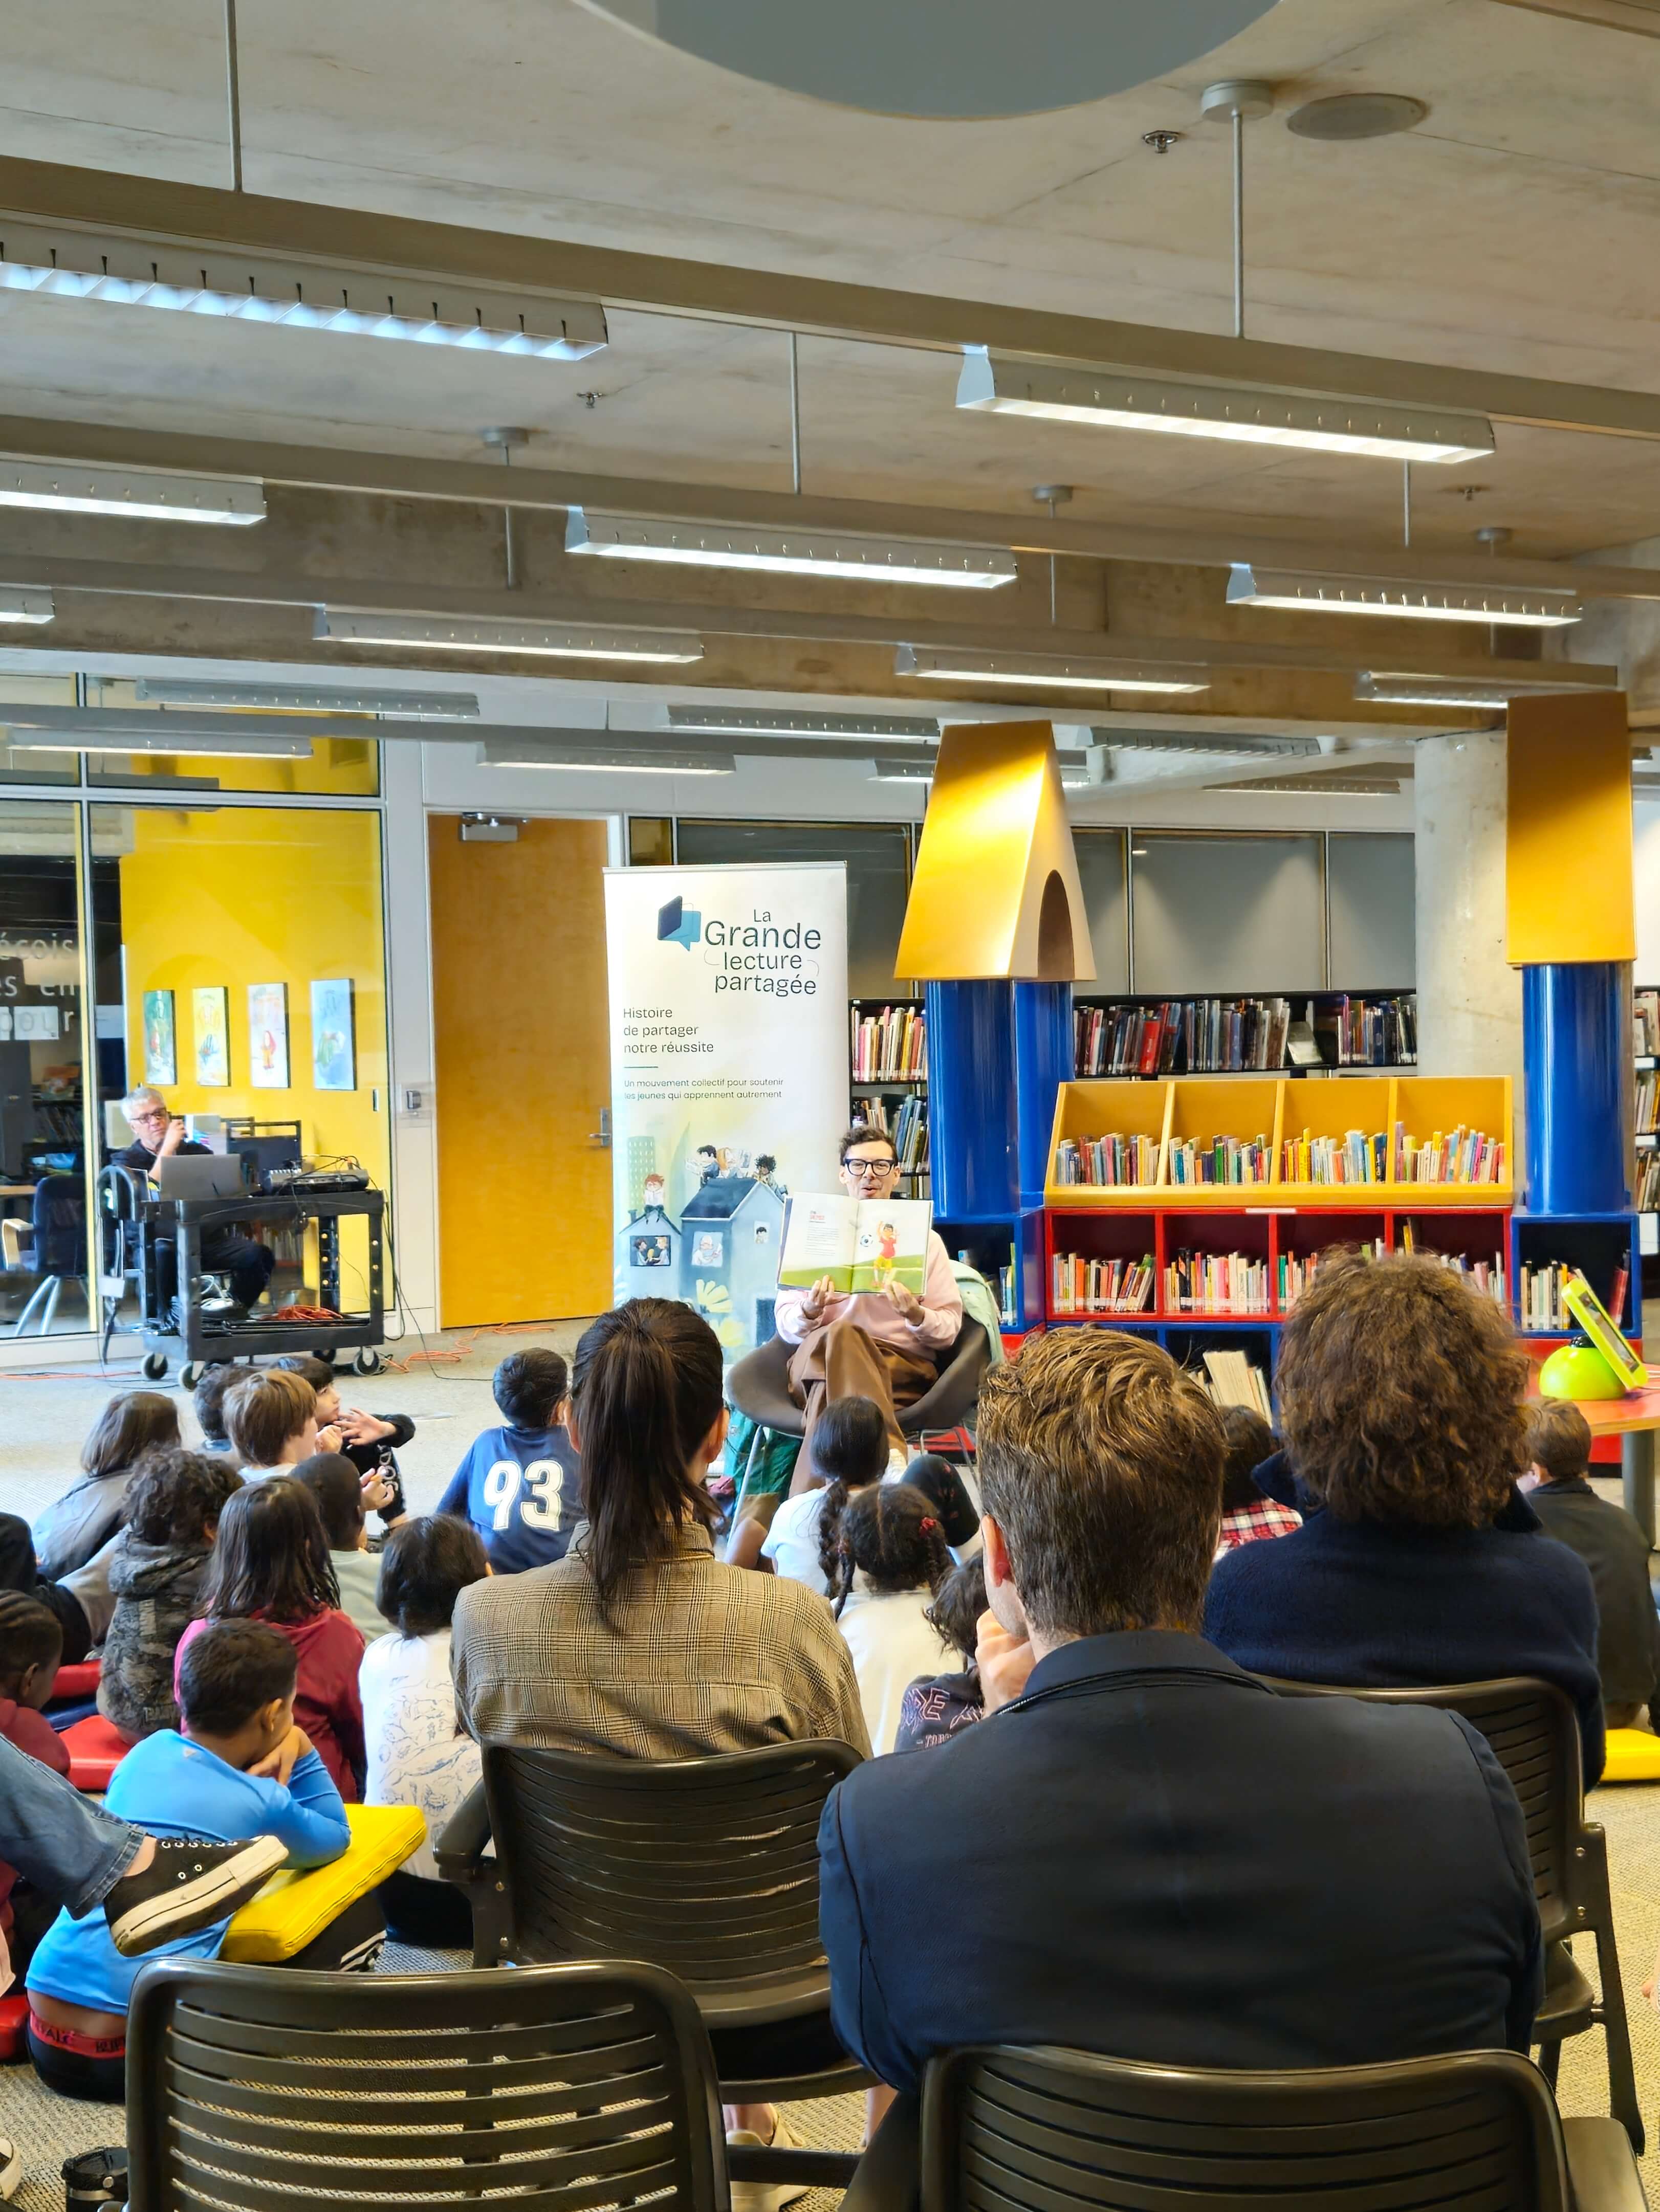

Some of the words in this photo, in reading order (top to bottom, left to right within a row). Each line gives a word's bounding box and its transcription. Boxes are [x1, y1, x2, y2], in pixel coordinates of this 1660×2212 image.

[753, 909, 771, 922] La
[705, 920, 821, 950] Grande
[724, 952, 802, 970] lecture
[715, 974, 816, 997] partagée
[623, 1008, 672, 1019] Histoire
[623, 1025, 639, 1036] de
[643, 1026, 699, 1038] partager
[624, 1044, 658, 1053] notre
[662, 1041, 714, 1053] réussite
[624, 1079, 635, 1088] Un
[691, 1078, 725, 1087] collectif
[727, 1079, 748, 1089] pour
[749, 1078, 784, 1087] soutenir
[624, 1091, 636, 1099] les
[637, 1092, 666, 1101] jeunes
[667, 1092, 682, 1101] qui
[683, 1091, 734, 1101] apprennent
[736, 1091, 782, 1099] autrement
[484, 1458, 563, 1531] 93
